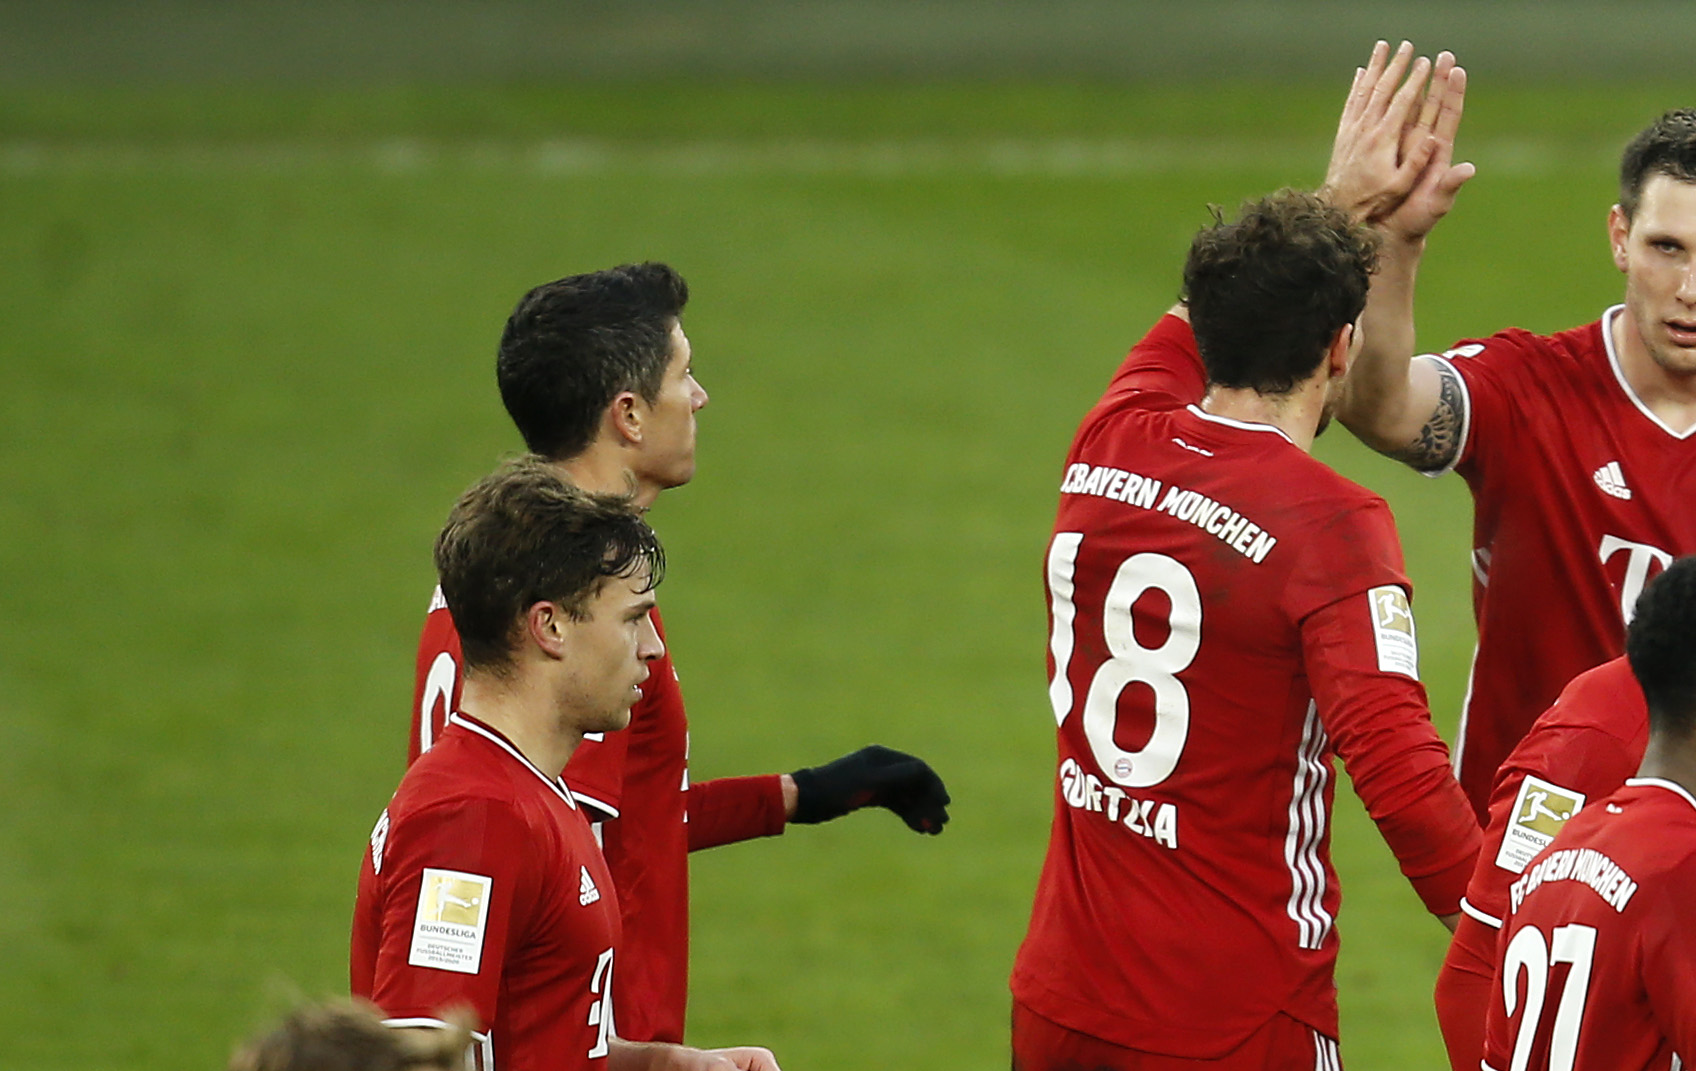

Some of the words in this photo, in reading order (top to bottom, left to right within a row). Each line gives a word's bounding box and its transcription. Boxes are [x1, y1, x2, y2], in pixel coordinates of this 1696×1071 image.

[1070, 463, 1162, 509] BAYERN
[1047, 532, 1203, 788] 18
[420, 923, 477, 940] BUNDESLIGA
